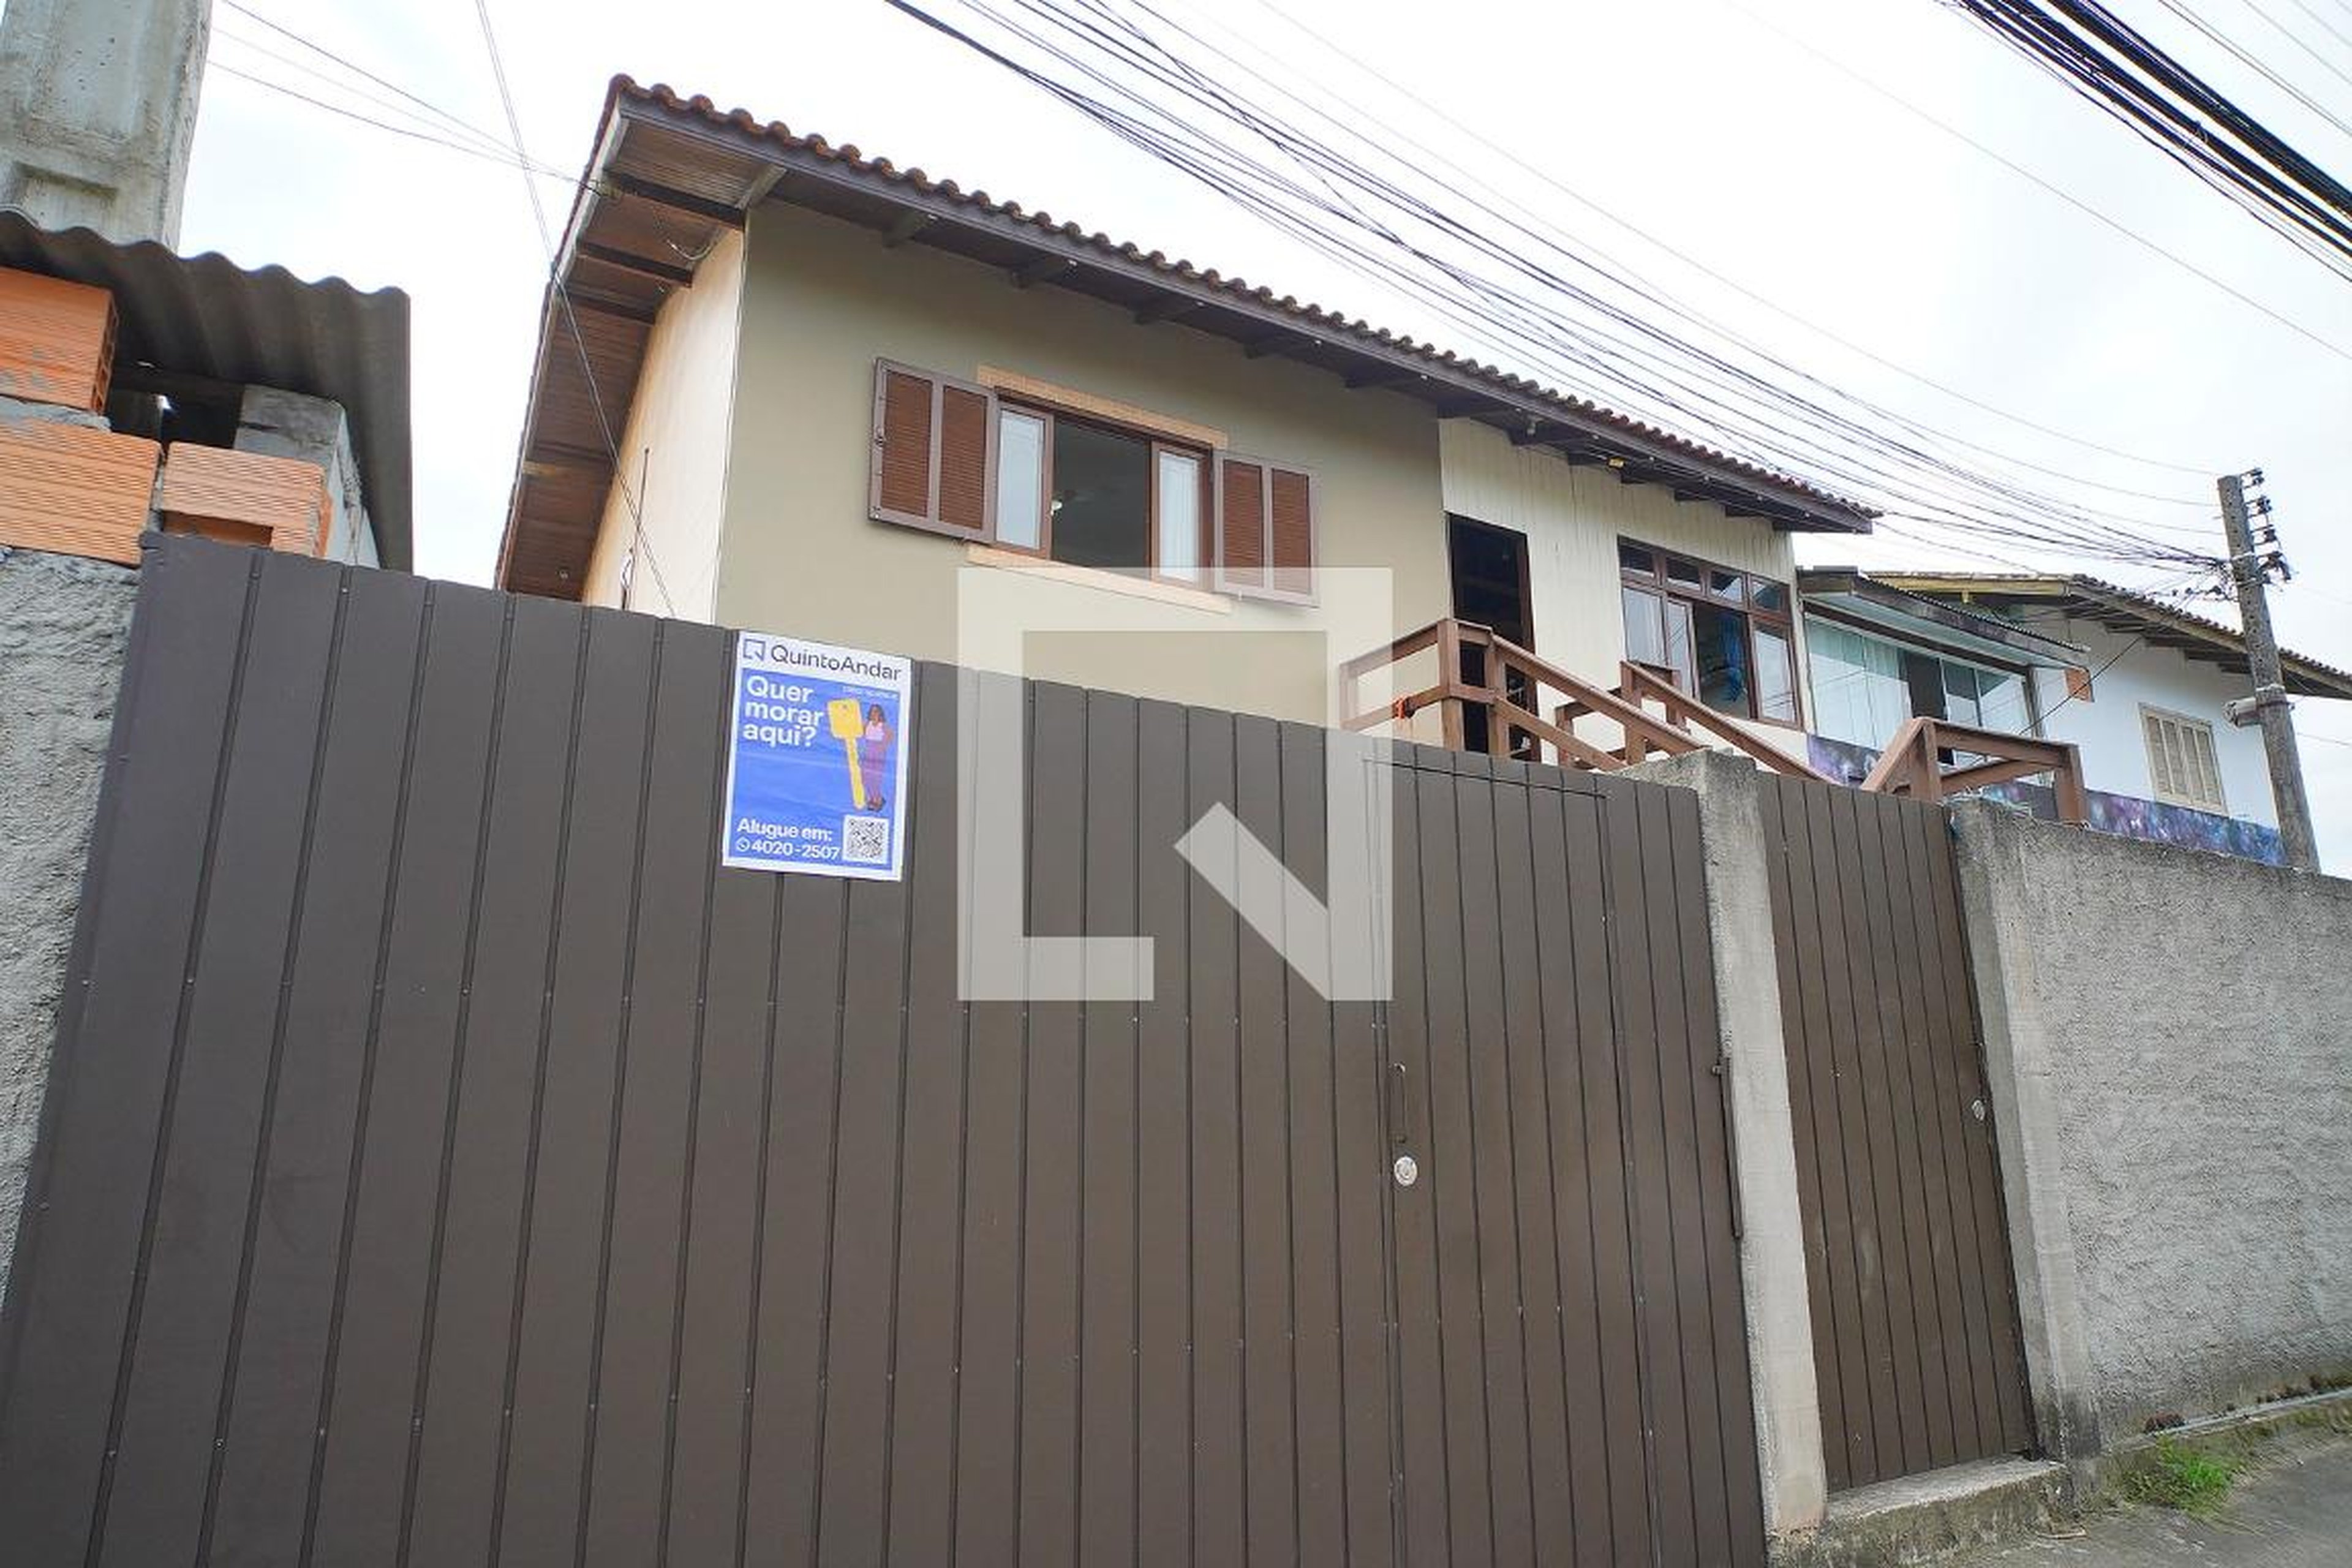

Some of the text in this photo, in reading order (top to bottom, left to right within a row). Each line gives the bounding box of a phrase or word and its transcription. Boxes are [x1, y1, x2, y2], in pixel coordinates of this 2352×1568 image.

[771, 645, 902, 681] QuintoAndar
[747, 676, 813, 703] Quer
[745, 701, 824, 726] morar
[743, 723, 817, 748] aqui?
[737, 818, 833, 842] Alugue em:
